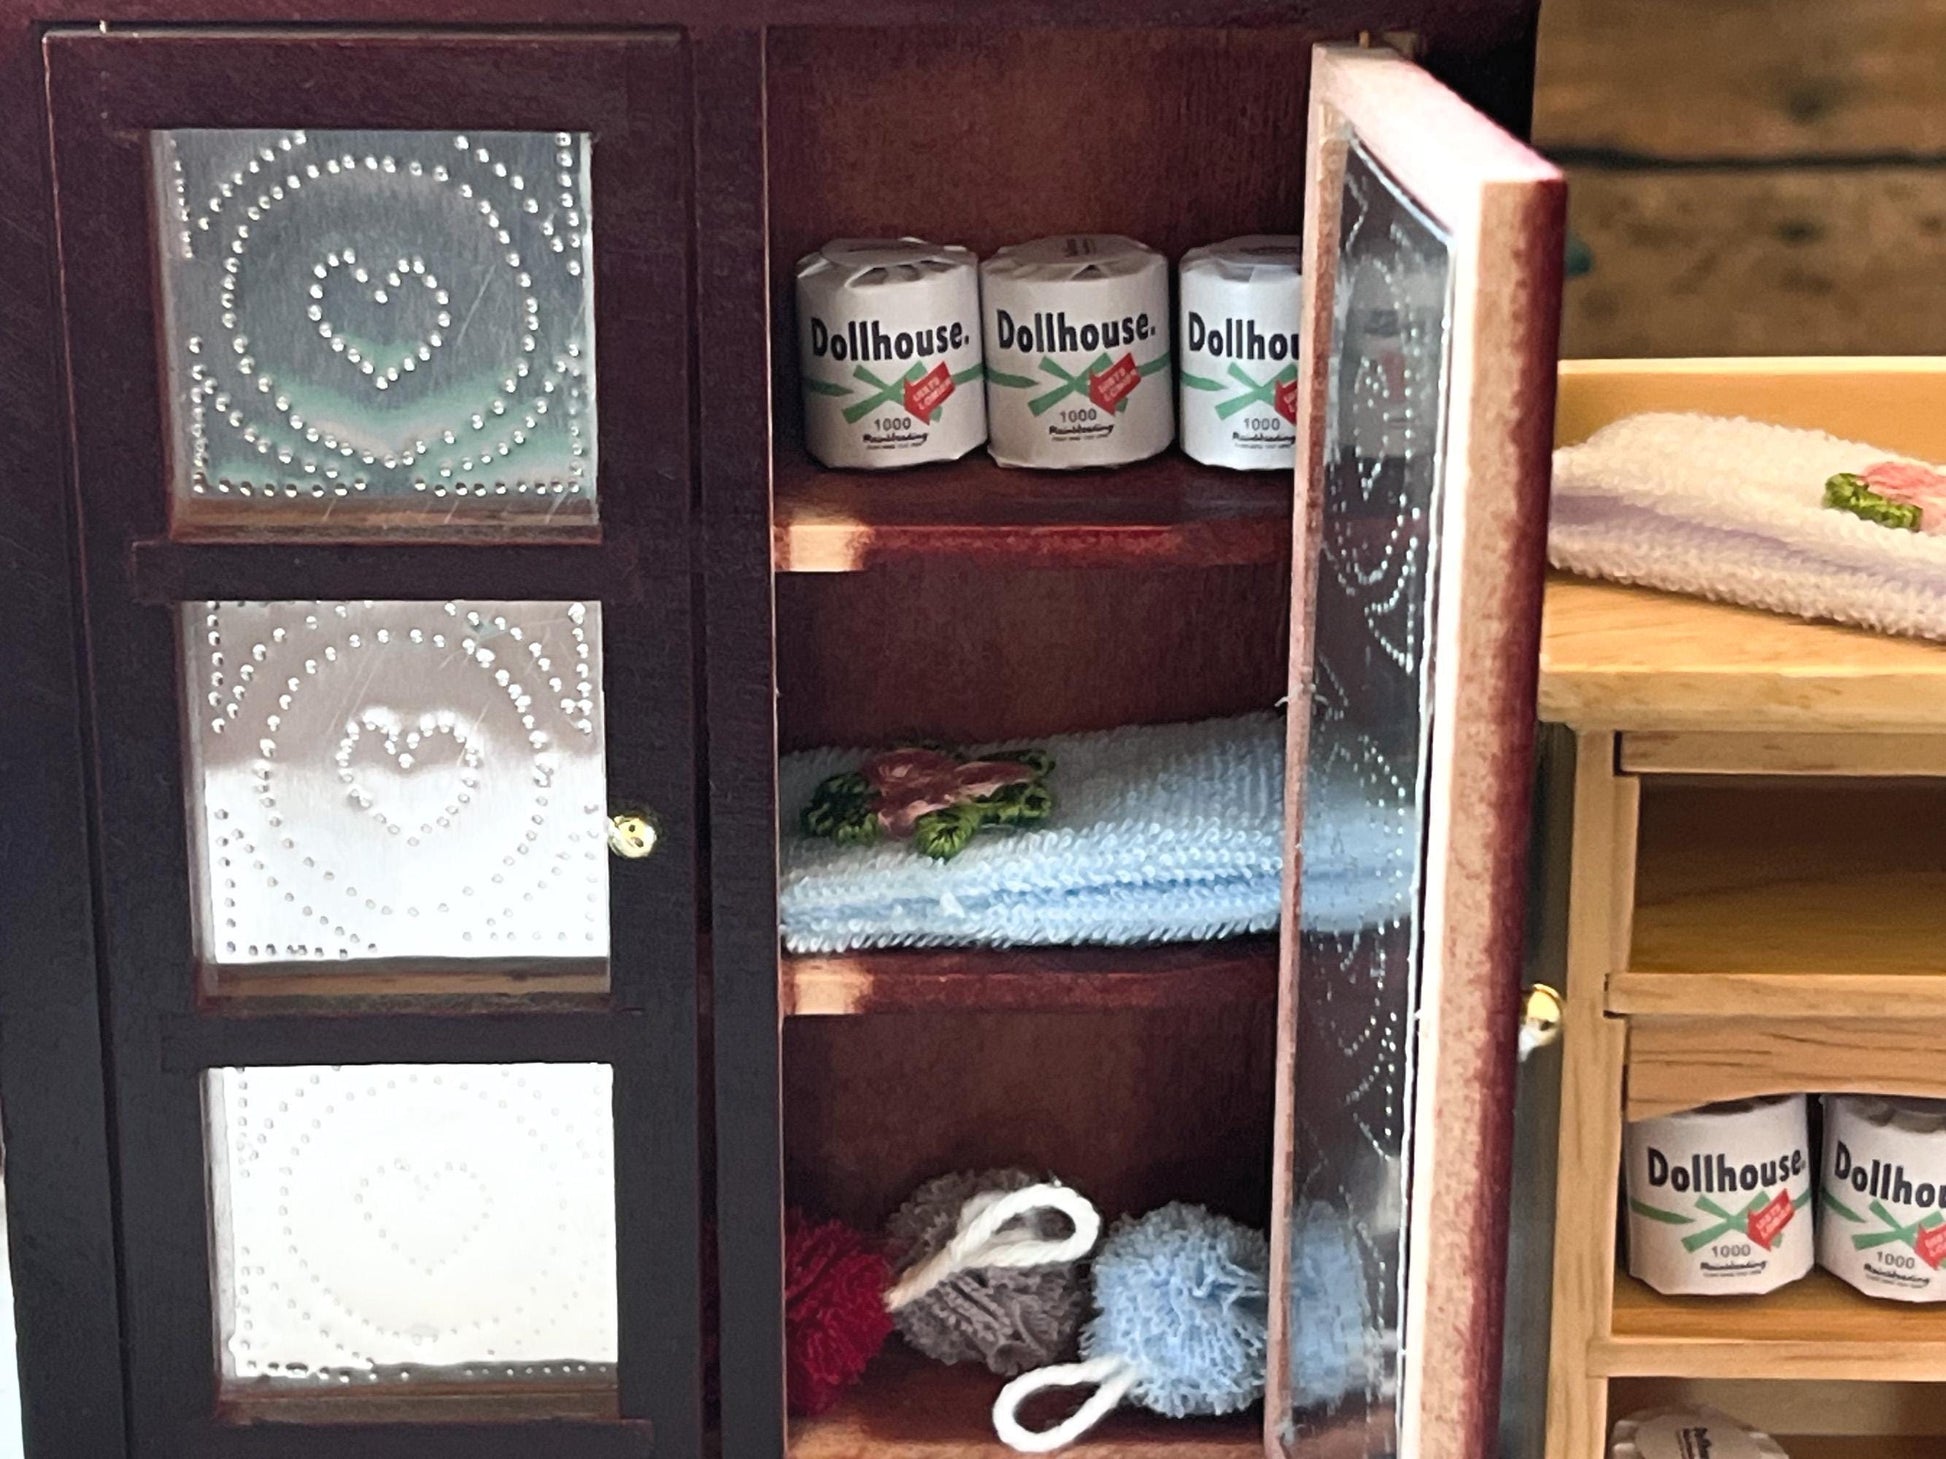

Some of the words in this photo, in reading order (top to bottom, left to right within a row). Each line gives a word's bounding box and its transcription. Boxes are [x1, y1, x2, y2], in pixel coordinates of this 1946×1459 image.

[997, 309, 1156, 353] Dollhouse.
[811, 317, 969, 361] Dollhouse.
[1059, 409, 1097, 423] 1000
[874, 417, 912, 431] 1000
[1243, 418, 1281, 431] 1000
[1711, 1244, 1751, 1258] 1000
[1876, 1250, 1916, 1270] 1000
